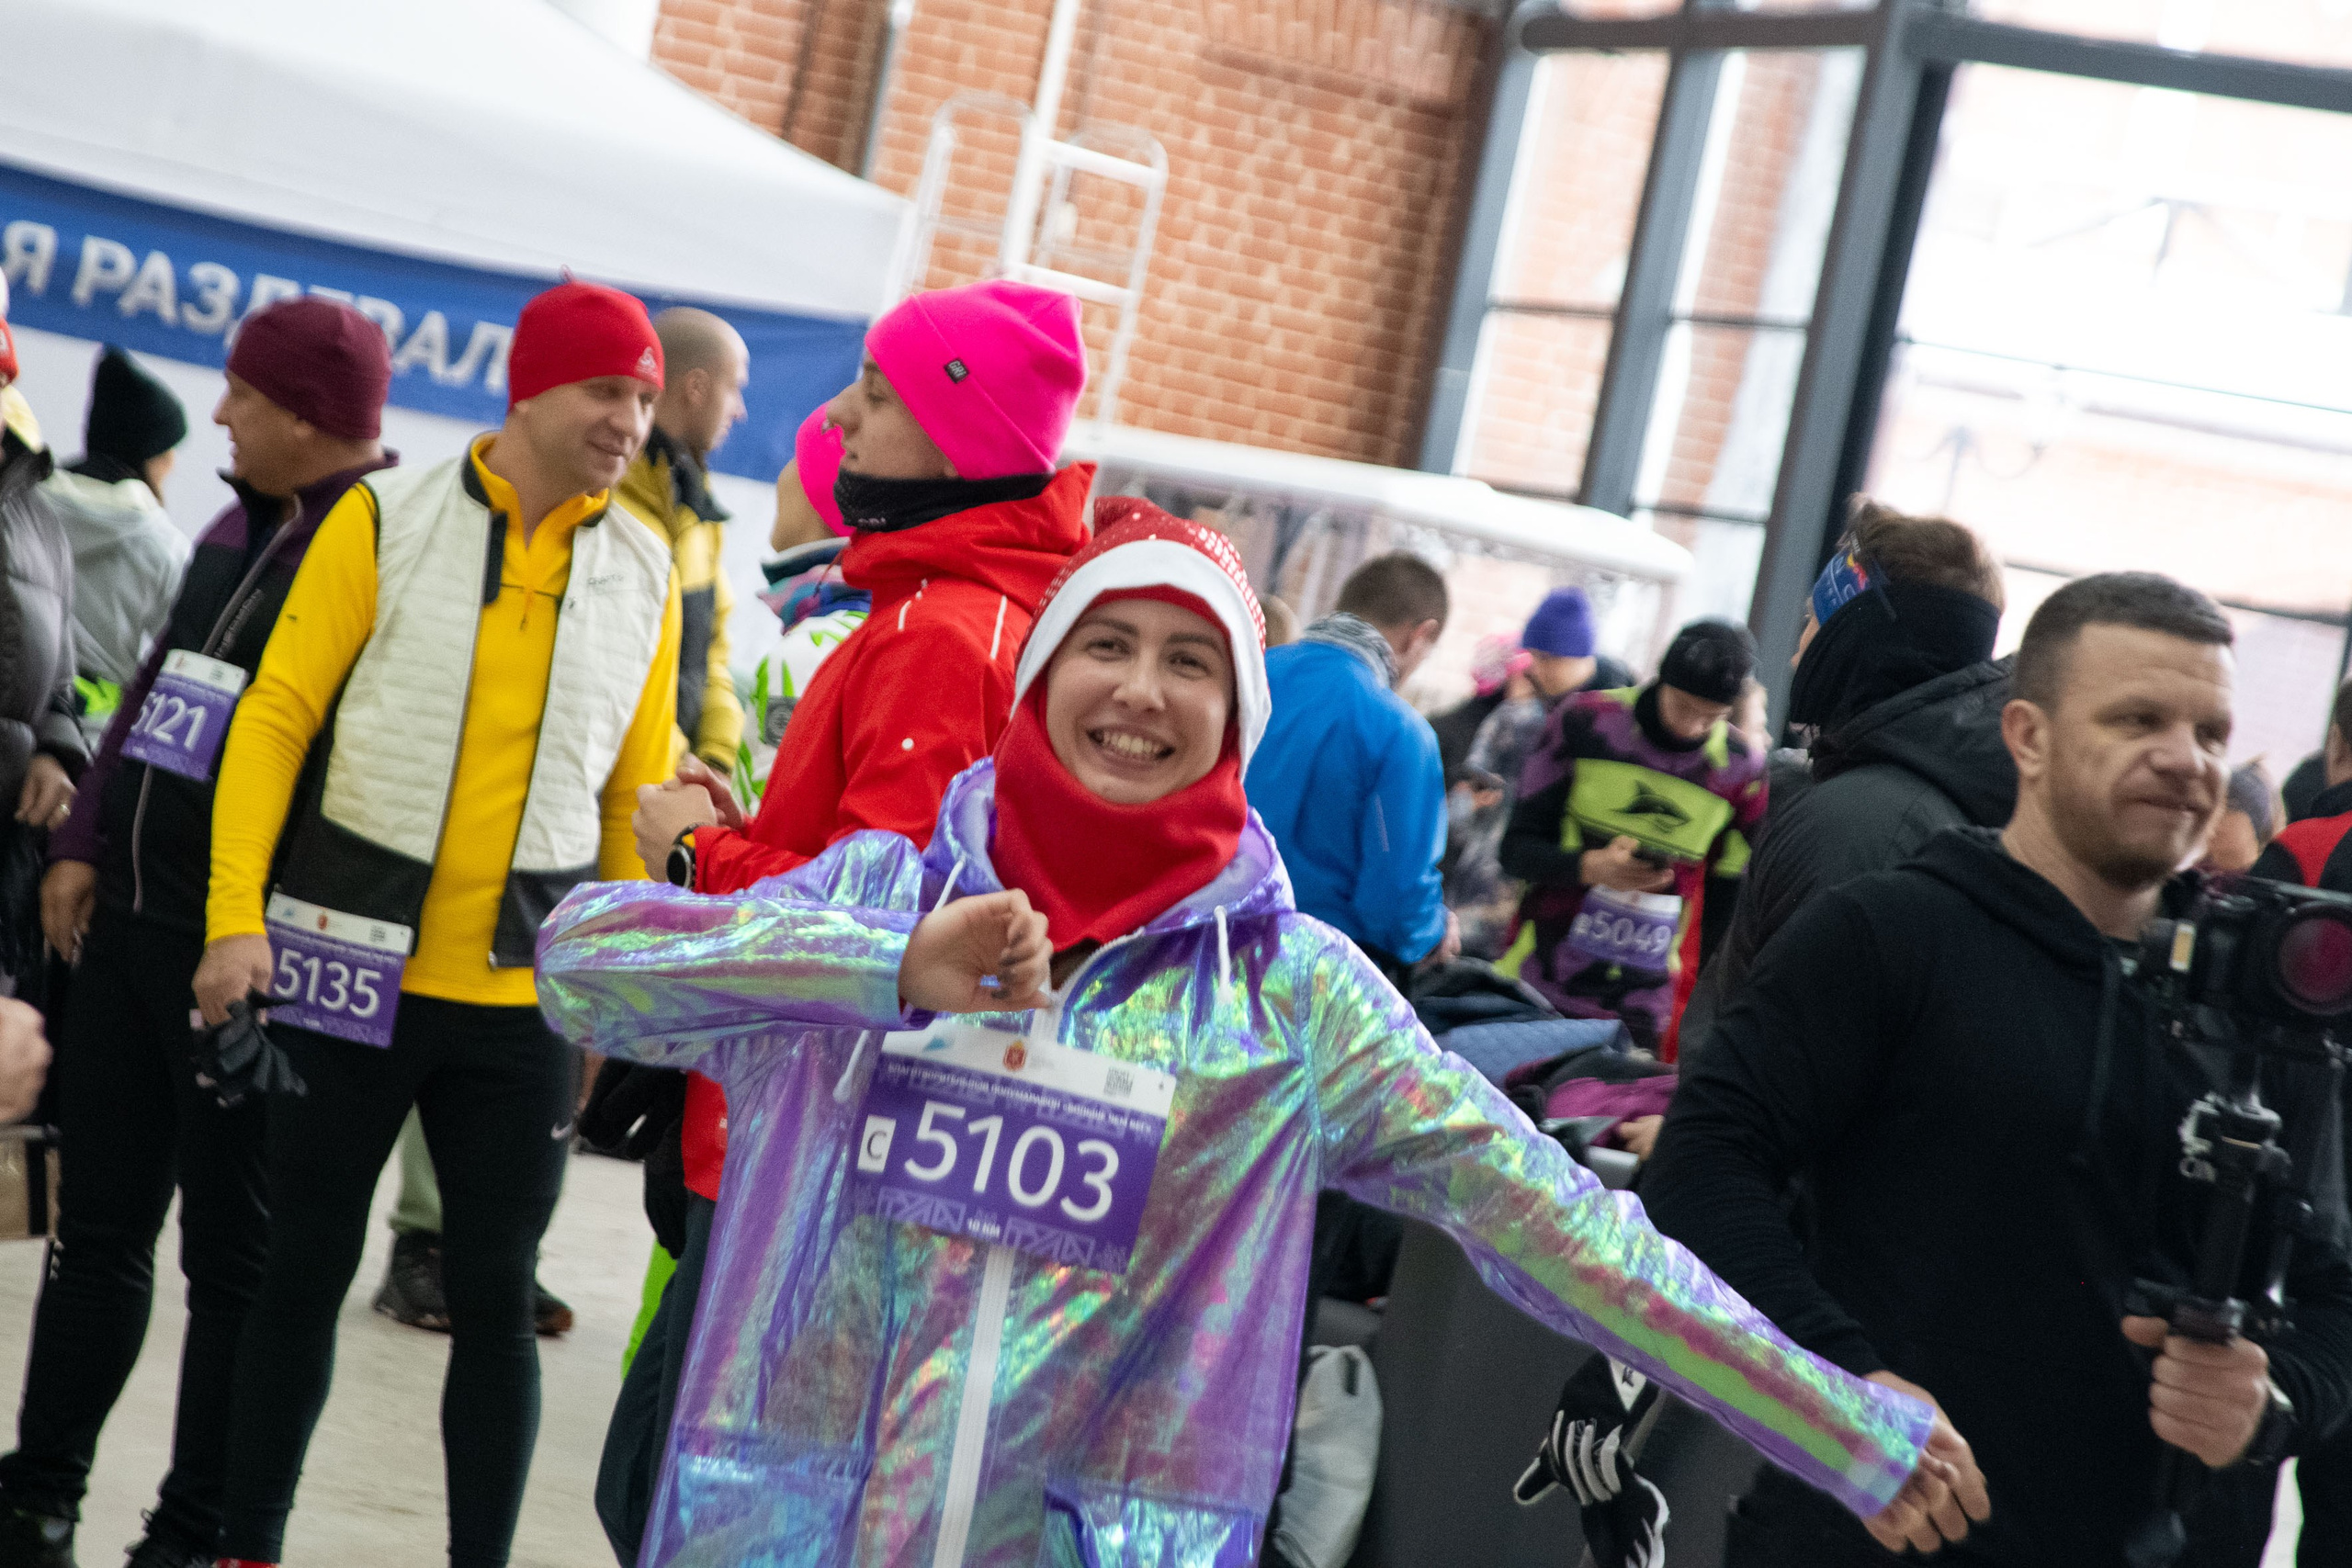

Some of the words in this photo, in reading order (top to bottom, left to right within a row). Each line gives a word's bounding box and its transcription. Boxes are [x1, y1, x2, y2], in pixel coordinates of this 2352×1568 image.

[2, 220, 58, 296] Я
[274, 947, 382, 1019] 5135
[904, 1100, 1120, 1223] 5103
